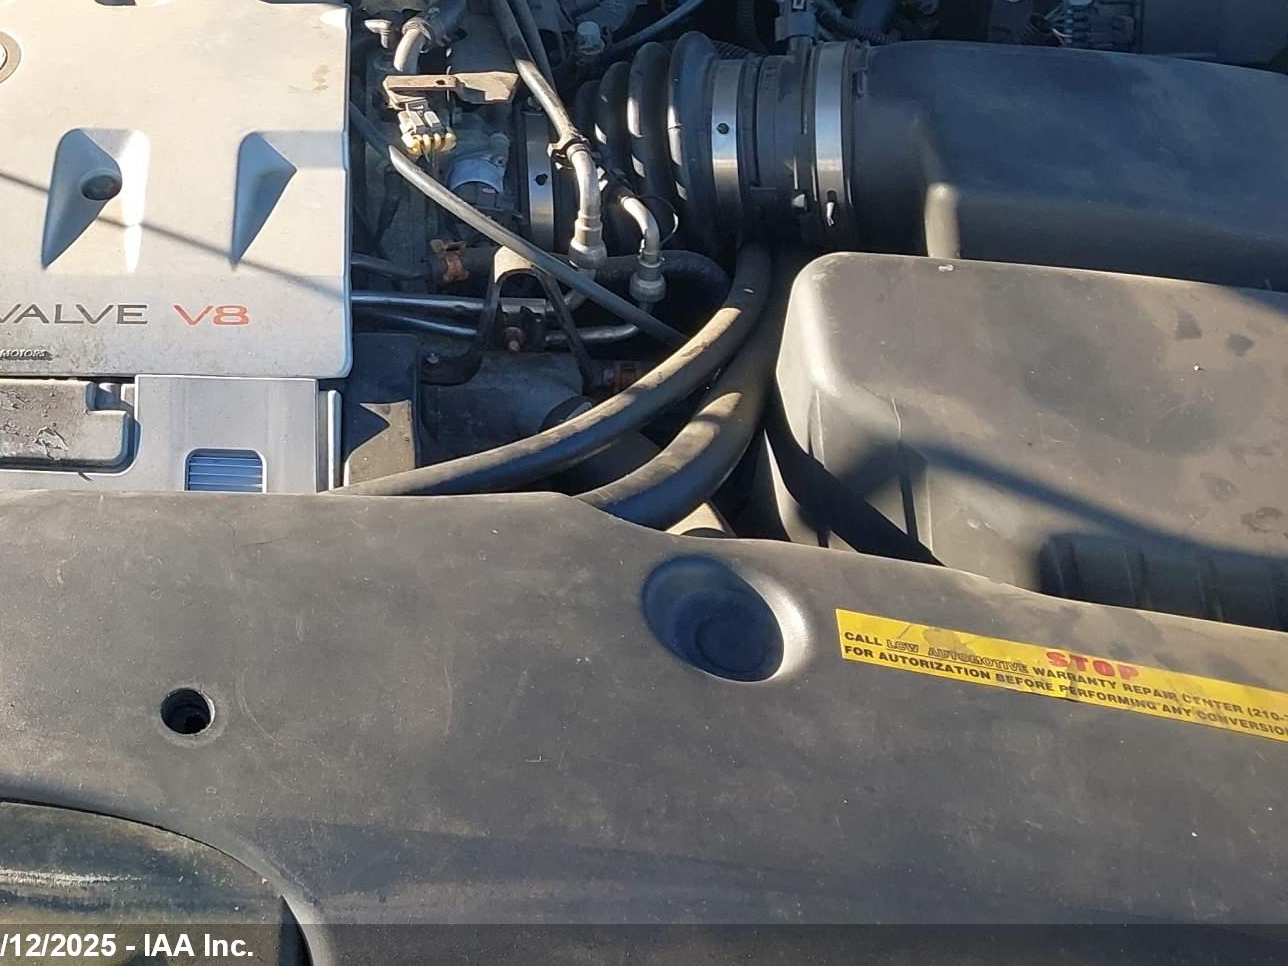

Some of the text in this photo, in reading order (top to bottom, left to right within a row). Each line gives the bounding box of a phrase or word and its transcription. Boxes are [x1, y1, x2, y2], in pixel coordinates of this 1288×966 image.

[173, 304, 252, 326] V8
[0, 349, 47, 358] MOTORS
[844, 631, 882, 646] CALL
[928, 647, 1029, 673] AUTOMOTIVE
[1032, 666, 1117, 689] WARRANTY
[1122, 683, 1177, 700] REPAIR
[1182, 693, 1243, 714] CENTER
[1047, 651, 1139, 680] STOP
[844, 645, 874, 659] FOR
[879, 651, 991, 680] AUTORIZATION
[995, 673, 1054, 692] BEFORE
[1059, 685, 1158, 710] PERFORMING
[1162, 704, 1192, 717] ANY
